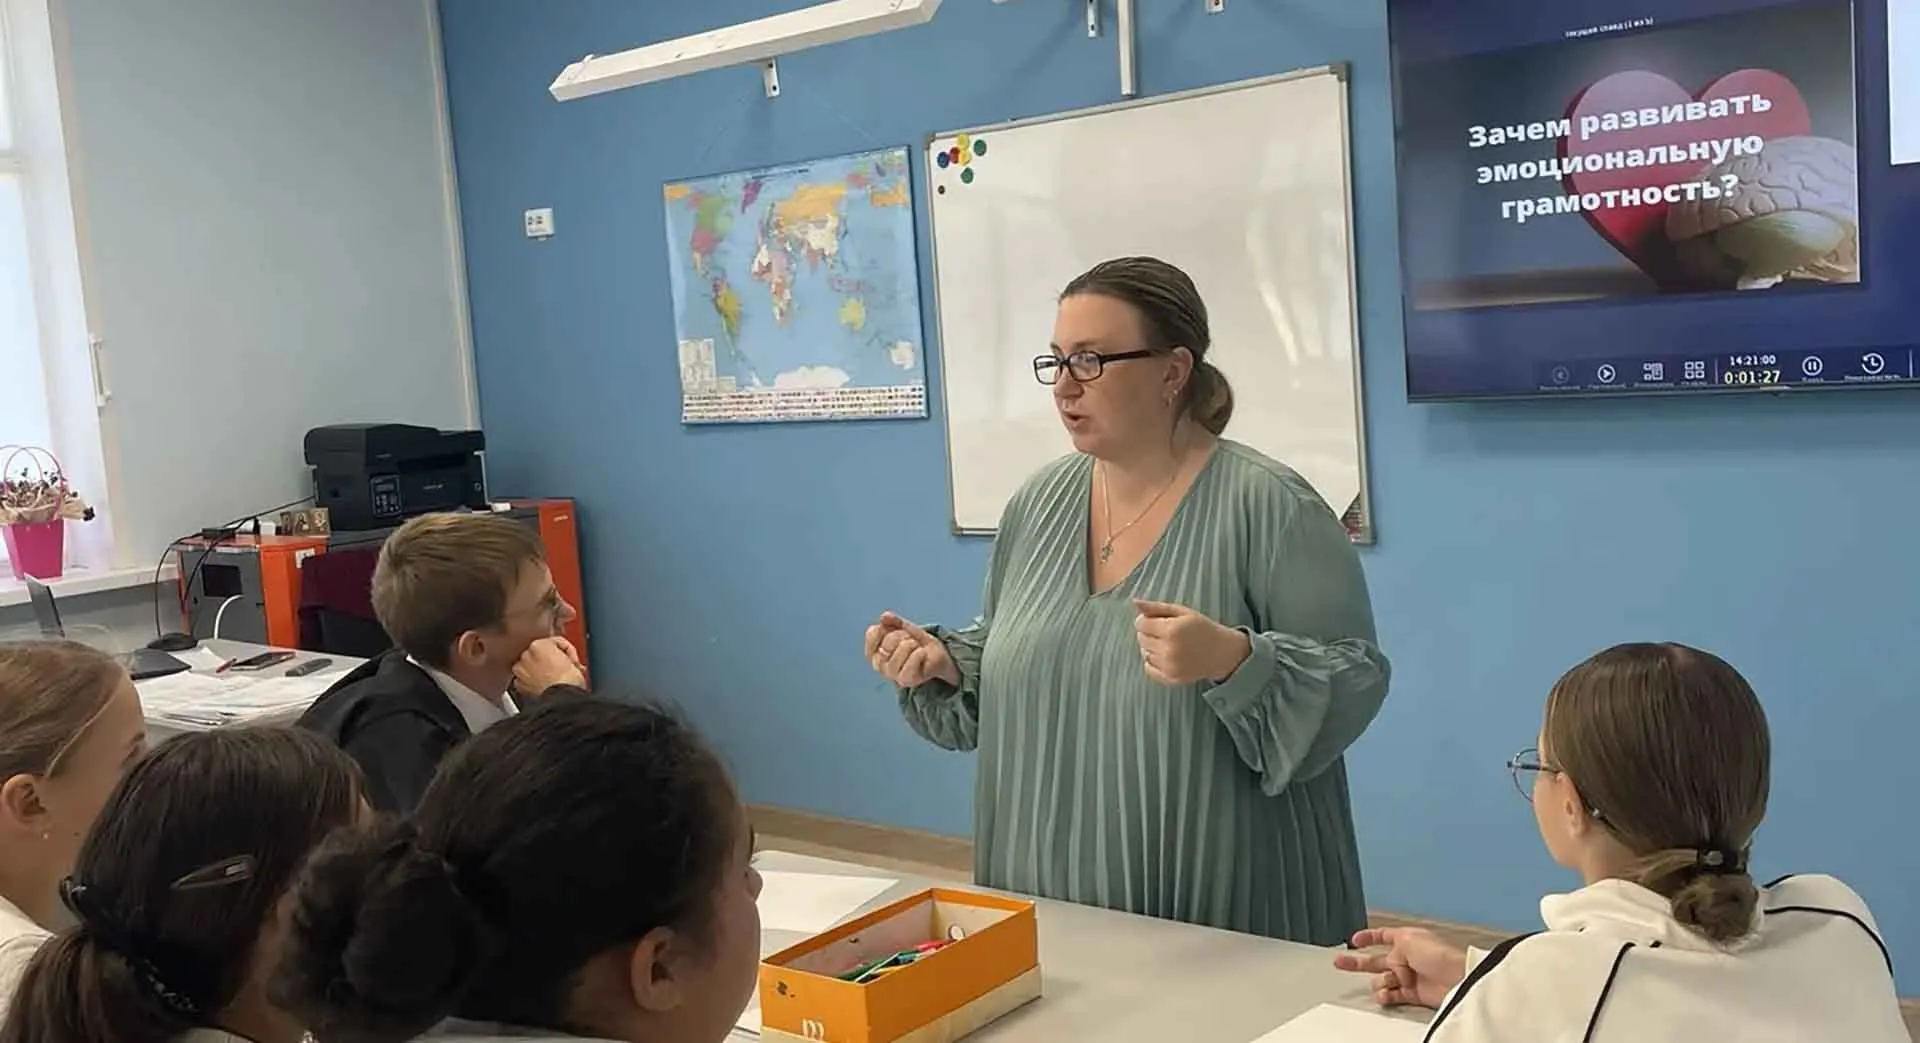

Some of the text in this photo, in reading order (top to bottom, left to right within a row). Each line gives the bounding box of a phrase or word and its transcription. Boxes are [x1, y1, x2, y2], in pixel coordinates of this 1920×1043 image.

[1468, 93, 1773, 148] Зачем развивать
[1477, 135, 1764, 184] эмоциональную
[1501, 174, 1739, 223] грамотность?
[1724, 370, 1781, 385] 0:01:27
[1729, 355, 1777, 366] 14:21:00
